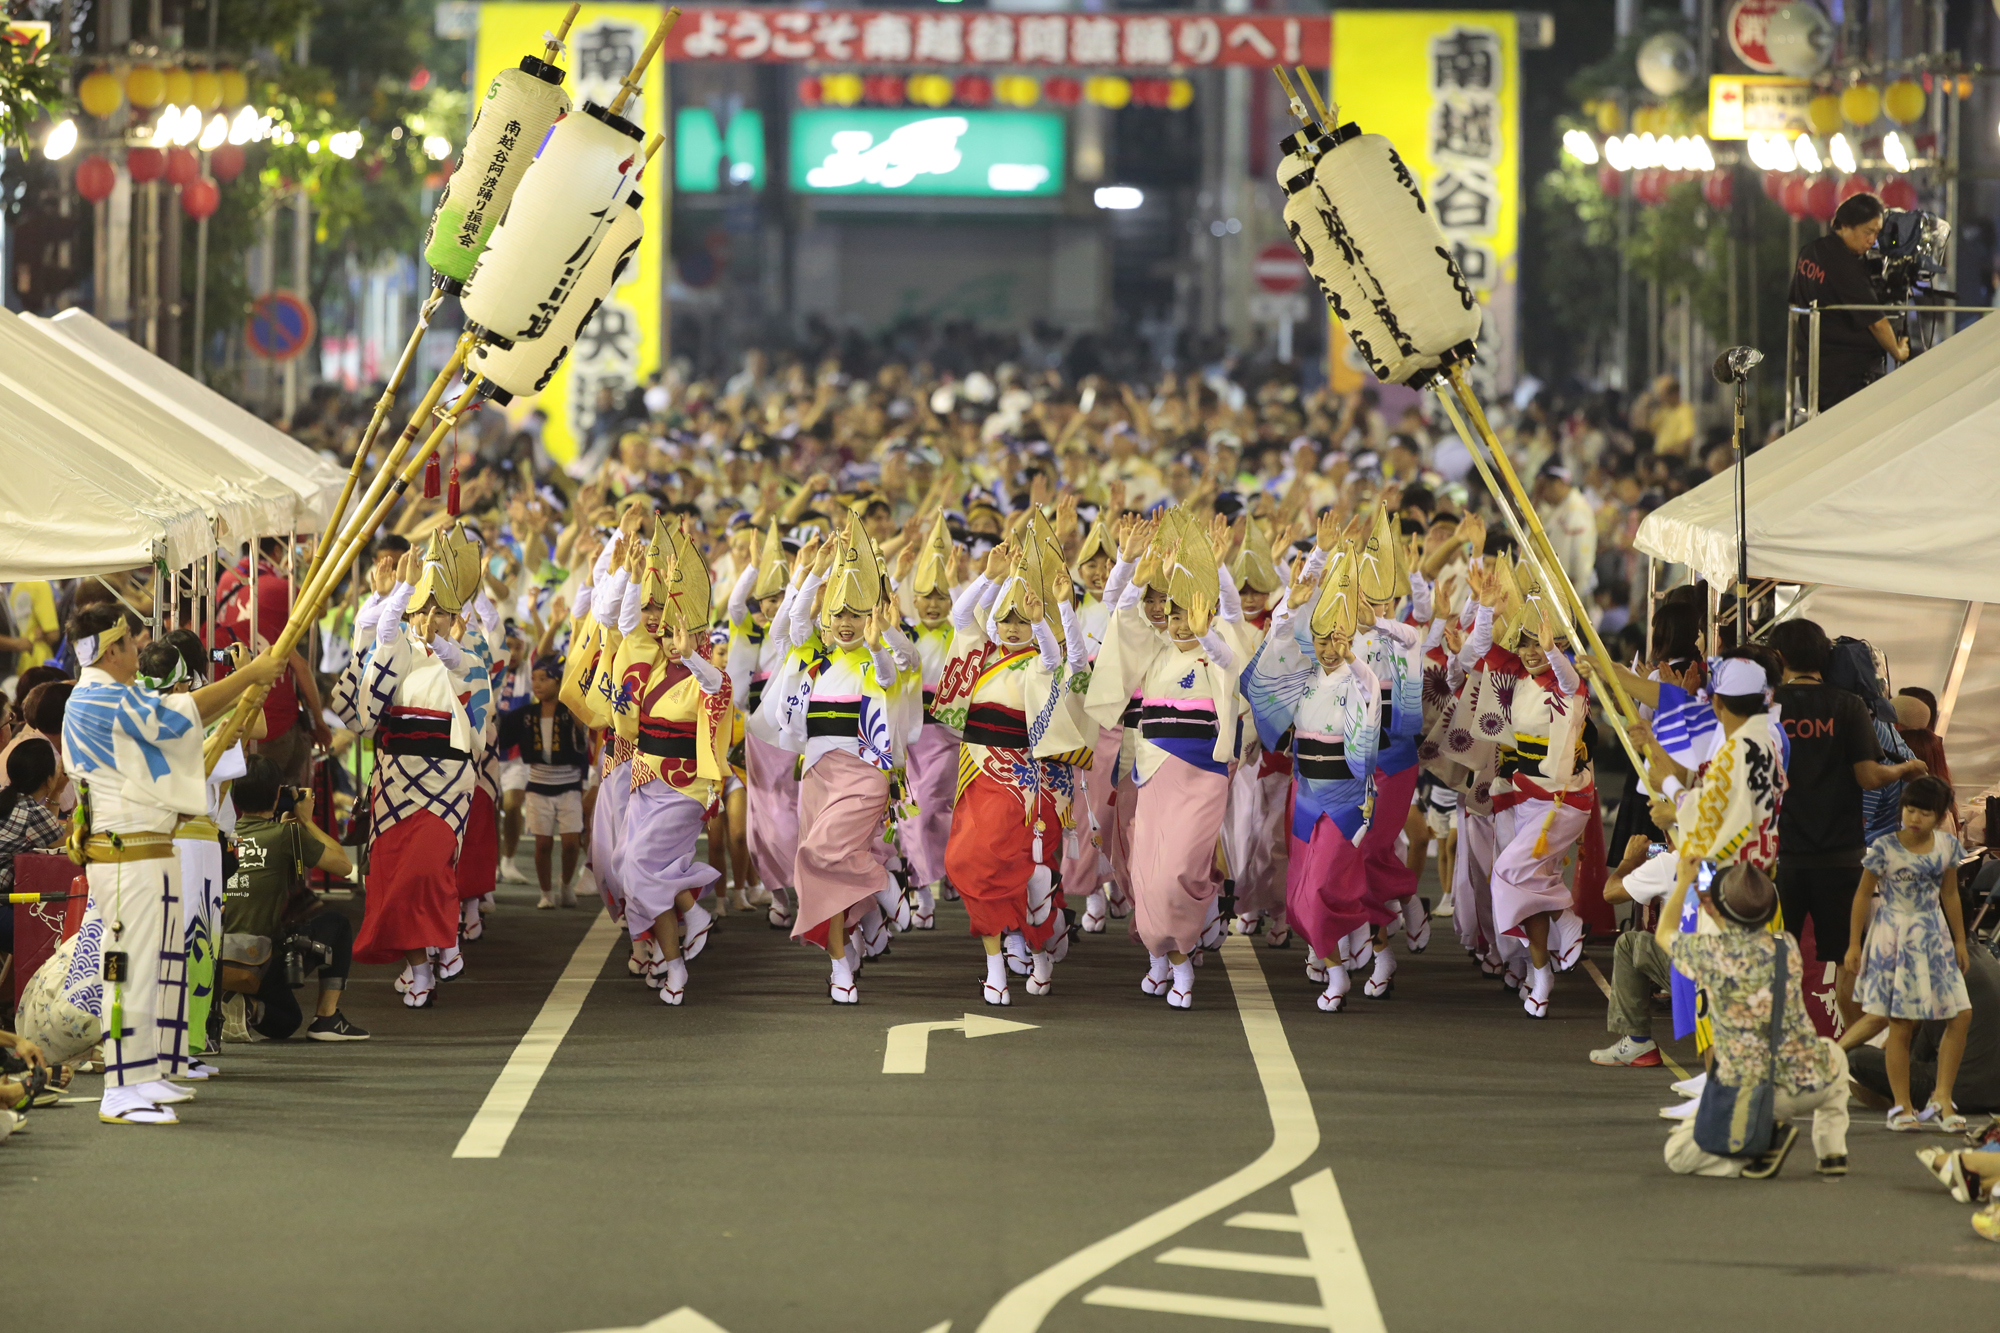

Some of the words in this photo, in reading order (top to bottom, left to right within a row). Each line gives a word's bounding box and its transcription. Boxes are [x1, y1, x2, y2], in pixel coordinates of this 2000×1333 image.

[458, 119, 522, 249] 南越谷阿波踊り振興会
